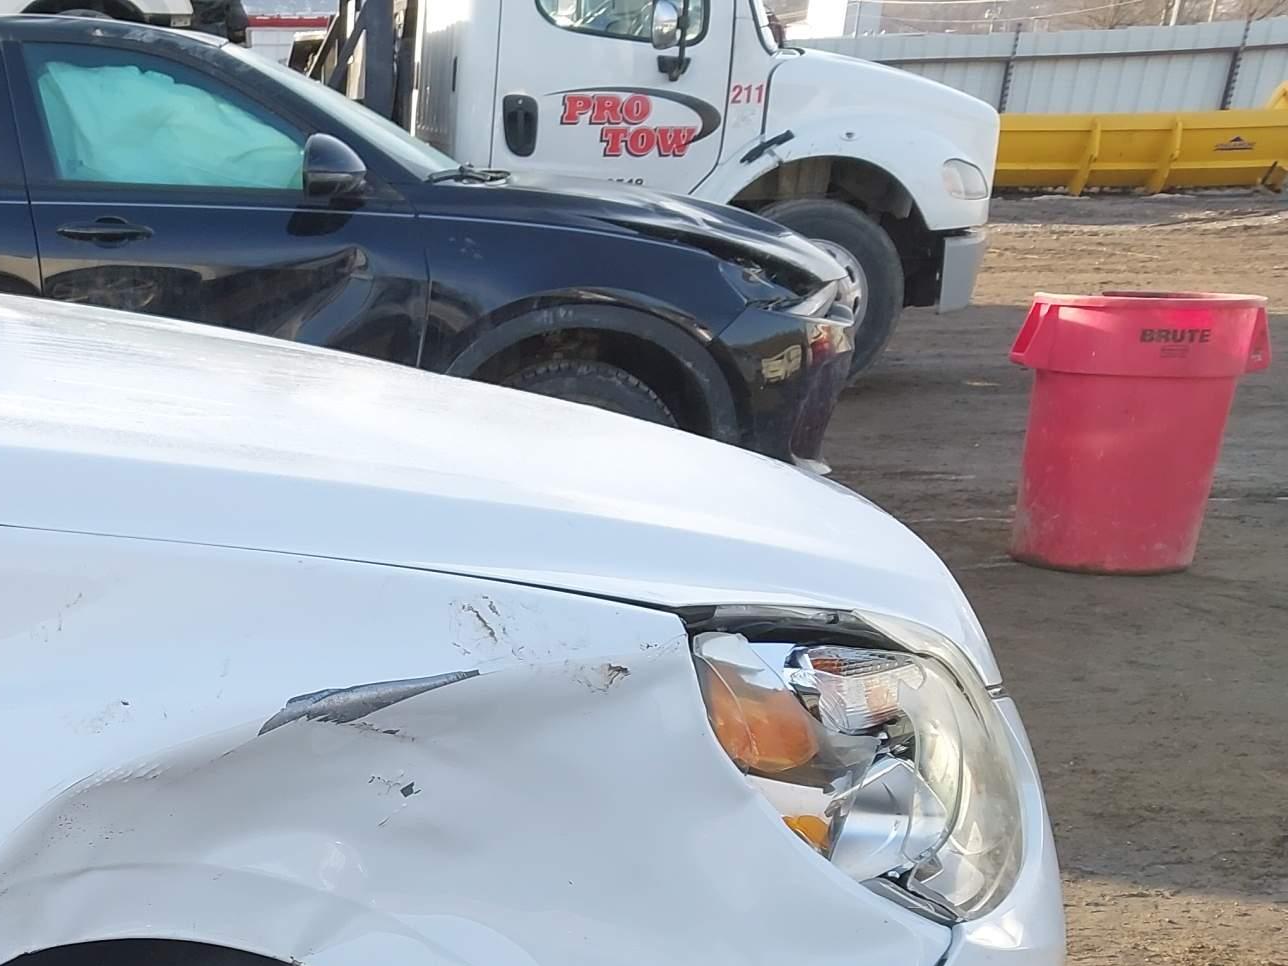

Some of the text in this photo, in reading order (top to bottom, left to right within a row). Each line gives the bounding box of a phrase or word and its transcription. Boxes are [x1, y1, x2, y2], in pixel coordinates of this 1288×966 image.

[731, 84, 764, 105] 211
[561, 93, 653, 125] PRO
[601, 126, 696, 158] TOW
[1140, 328, 1211, 343] BRUTE
